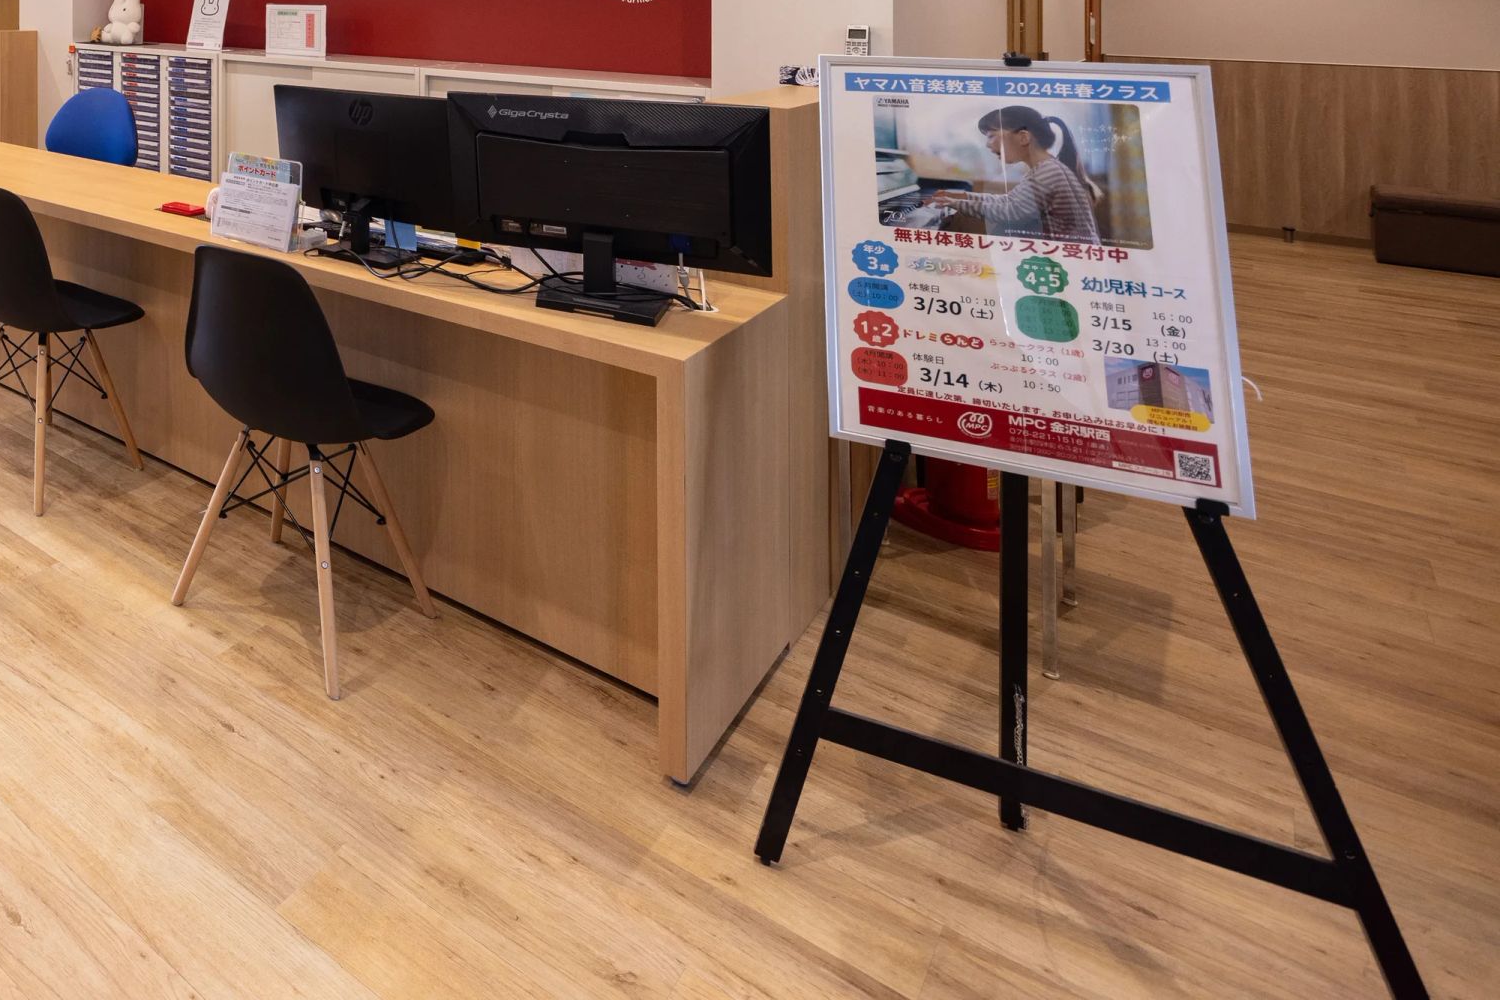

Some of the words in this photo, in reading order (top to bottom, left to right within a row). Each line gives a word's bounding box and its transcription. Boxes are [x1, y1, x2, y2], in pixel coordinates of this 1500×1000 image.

[853, 76, 985, 94] ヤマハ音楽教室
[1004, 81, 1160, 100] 2024年春クラス
[238, 165, 277, 178] ポイントカード
[862, 244, 886, 254] 年少
[894, 227, 1129, 264] 無料体験レッスン受付中
[908, 282, 941, 294] 体験日
[1025, 271, 1061, 288] 4・5
[913, 296, 962, 316] 3/30
[1090, 302, 1126, 313] 体験日
[860, 320, 893, 337] 1・2
[1091, 315, 1132, 332] 3/15
[903, 329, 983, 349] ドレミらんど
[1091, 339, 1135, 356] 3/30
[913, 352, 945, 365] 体験日
[920, 367, 969, 388] 3/14
[867, 405, 943, 424] 音楽のある暮らし
[1008, 415, 1047, 430] MPC
[1050, 421, 1110, 442] 金沢駅西
